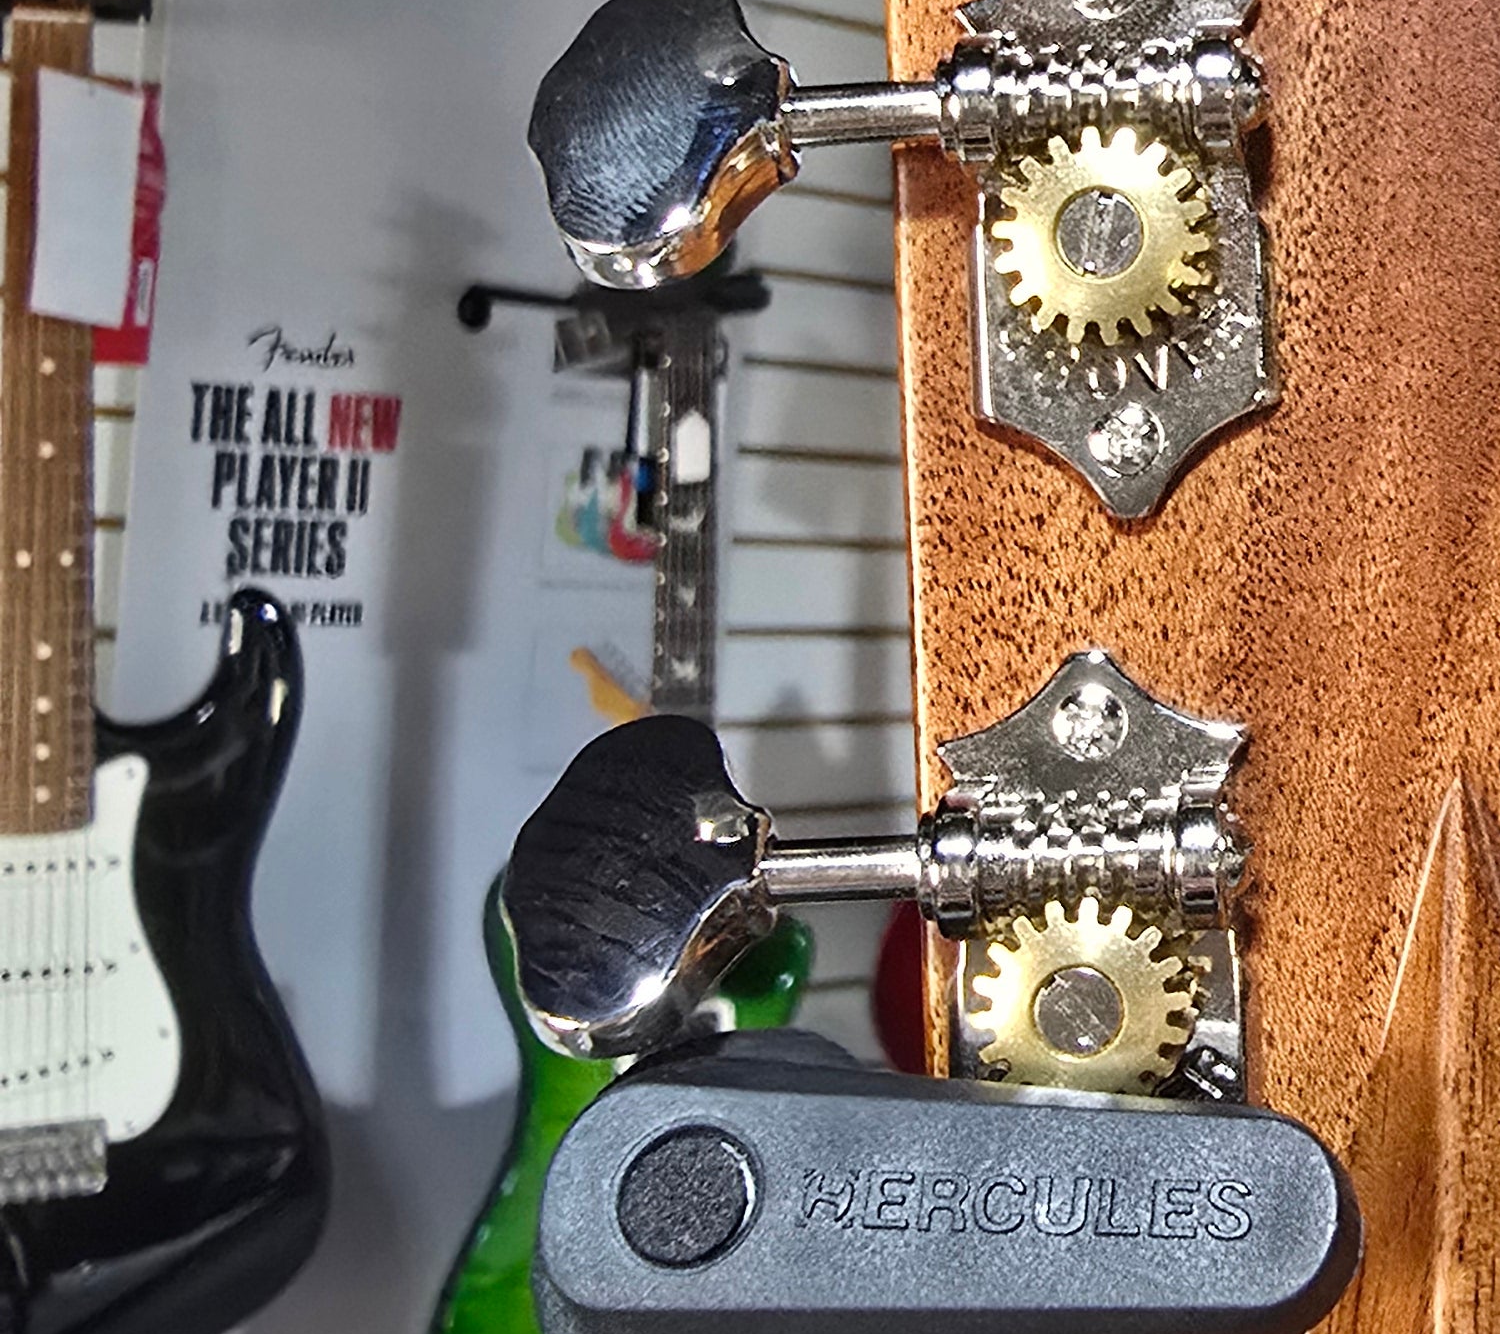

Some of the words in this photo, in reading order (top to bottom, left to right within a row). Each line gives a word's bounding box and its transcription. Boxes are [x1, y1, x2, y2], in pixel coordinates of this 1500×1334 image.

[248, 327, 355, 372] Fender
[190, 381, 254, 443] THE
[261, 387, 317, 449] ALL
[327, 391, 402, 452] NEW
[211, 451, 339, 512] PLAYER
[346, 458, 371, 515] II
[226, 517, 348, 579] SERIES
[797, 1163, 1255, 1243] HERCULES
